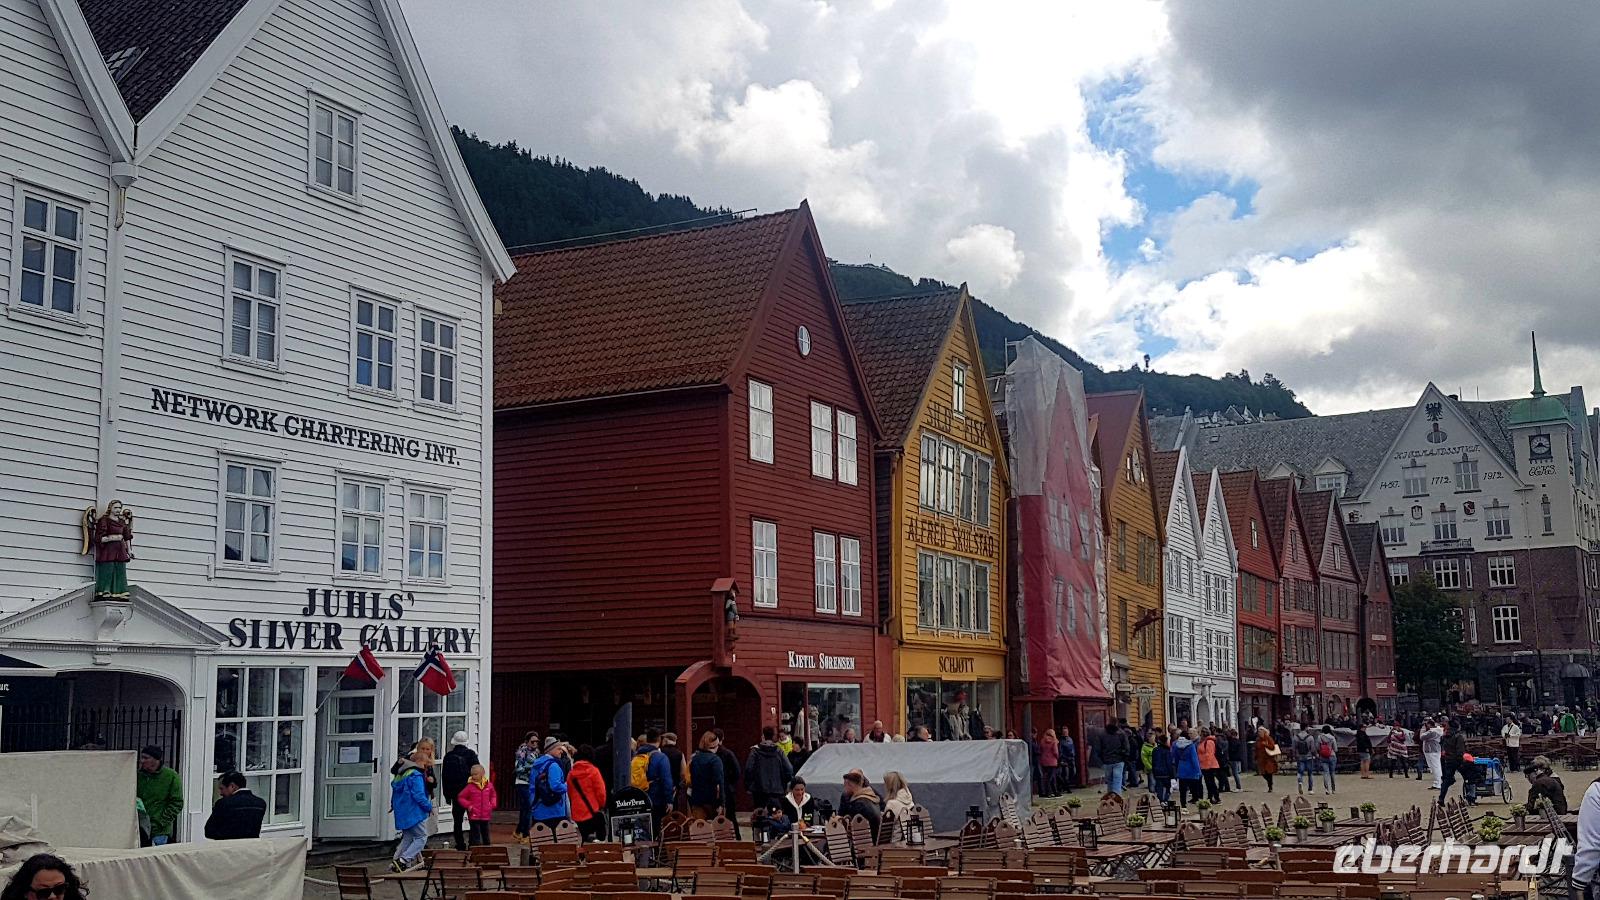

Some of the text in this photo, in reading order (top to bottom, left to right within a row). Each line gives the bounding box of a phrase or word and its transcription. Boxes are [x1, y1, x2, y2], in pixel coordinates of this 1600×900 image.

[151, 387, 461, 466] NETWORK CHARTERING INT.
[907, 517, 994, 558] ALFRED SKULSTAD
[229, 617, 476, 654] SILVER GALLERY
[788, 650, 855, 670] KJETIL SØRENSEN
